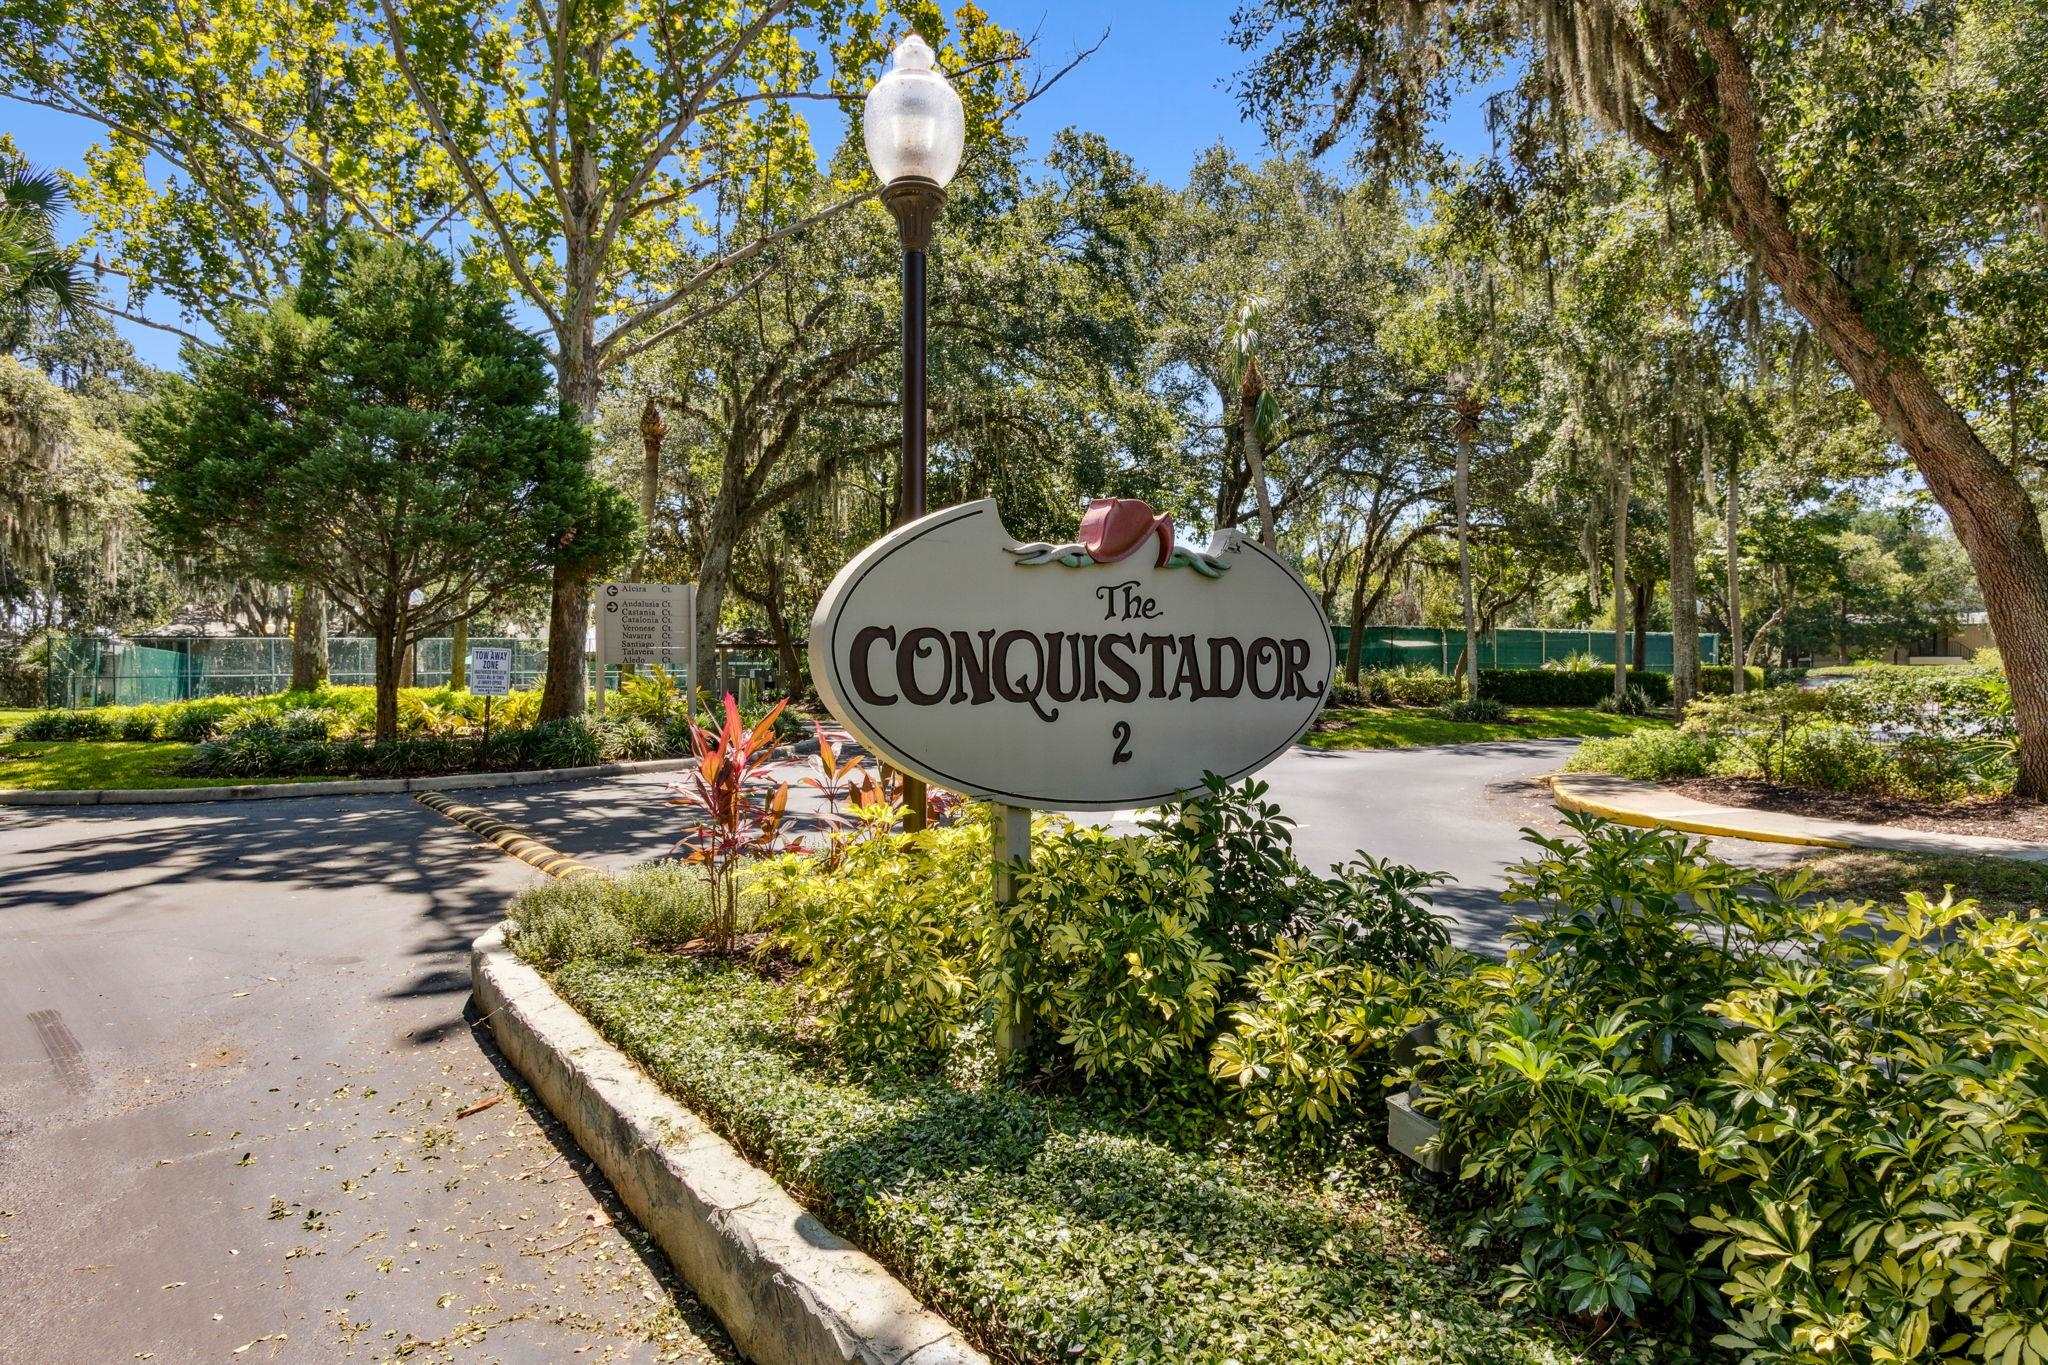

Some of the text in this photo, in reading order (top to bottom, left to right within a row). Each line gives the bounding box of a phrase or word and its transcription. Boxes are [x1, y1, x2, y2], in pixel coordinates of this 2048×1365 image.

[622, 600, 660, 608] Andalusia
[1096, 580, 1164, 621] The
[622, 624, 656, 632] Veronese
[621, 640, 655, 649] Santiago
[476, 651, 508, 660] TOW AWAY
[622, 648, 655, 656] Talavera
[622, 656, 646, 664] Aledo
[482, 660, 499, 670] ZONE
[849, 624, 1325, 723] CONQUISTADOR
[1112, 720, 1133, 766] 2
